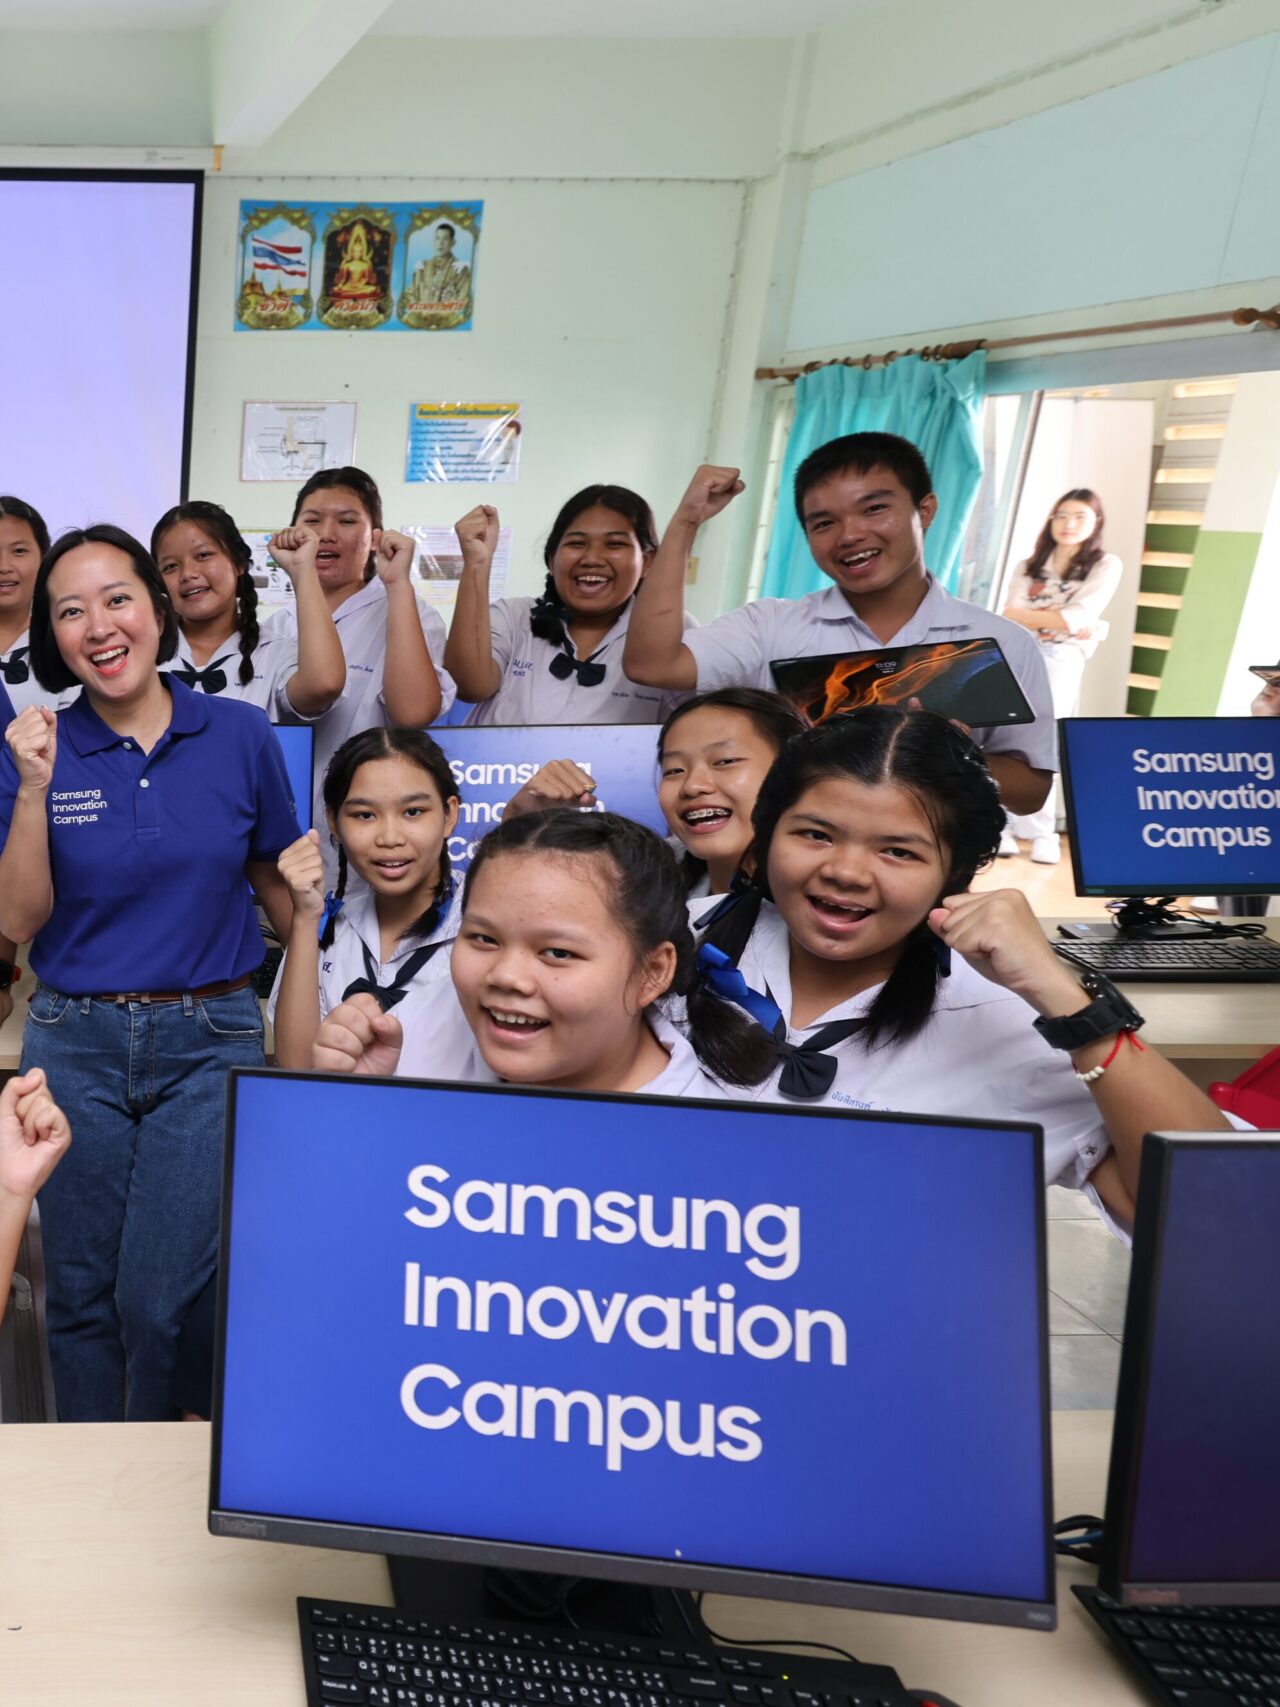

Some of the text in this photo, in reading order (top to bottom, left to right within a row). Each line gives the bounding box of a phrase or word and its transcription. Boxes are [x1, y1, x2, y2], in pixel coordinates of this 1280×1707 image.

[449, 760, 592, 785] Sams
[1132, 748, 1274, 780] Samsung
[51, 789, 101, 800] Samsung
[52, 800, 107, 812] Innovation
[53, 814, 98, 825] Campus
[1142, 822, 1271, 856] Campus
[404, 1164, 801, 1281] Samsung
[404, 1261, 847, 1366] Innovation
[400, 1363, 763, 1472] Campus
